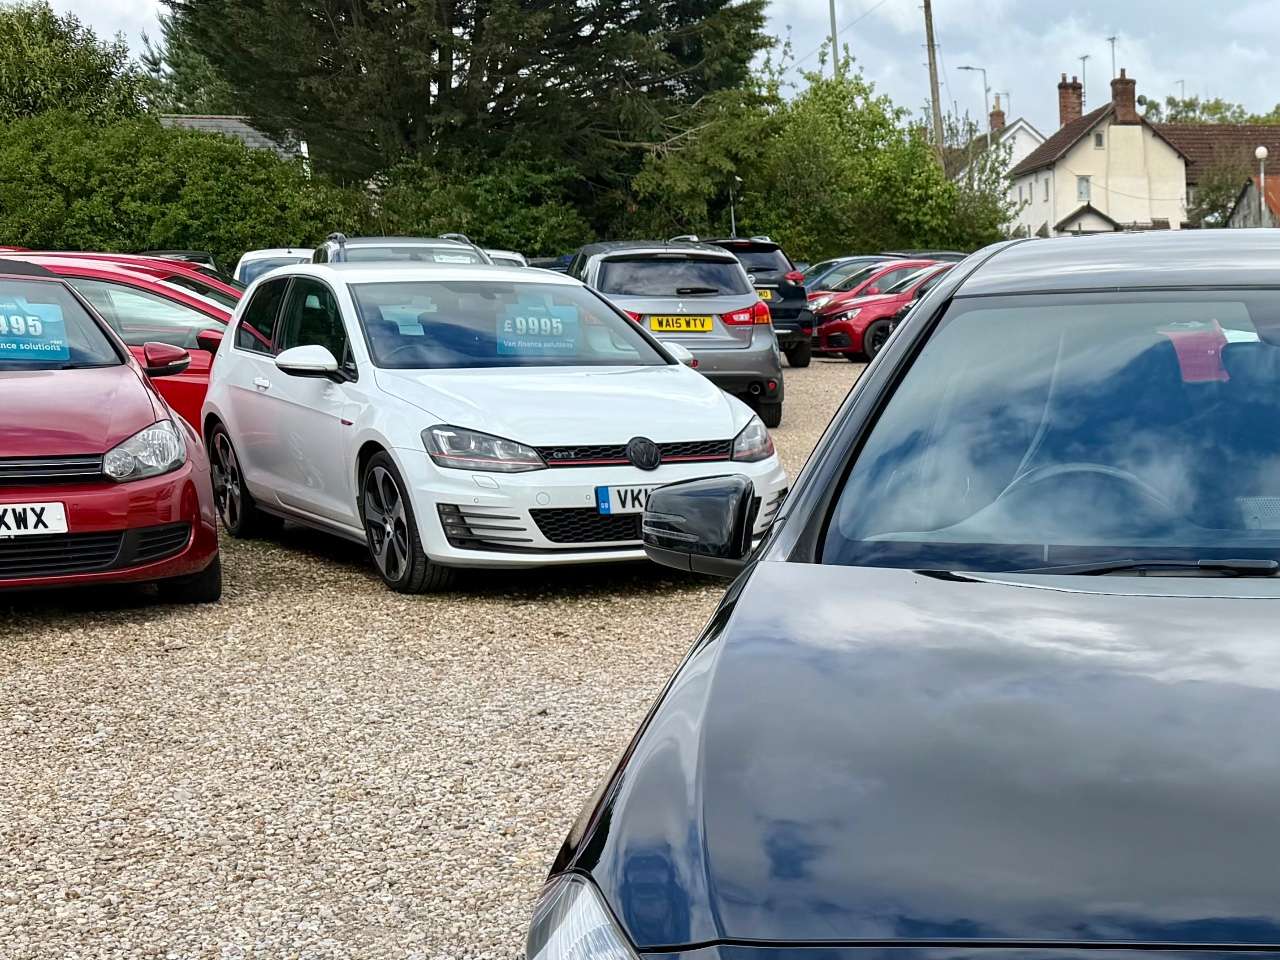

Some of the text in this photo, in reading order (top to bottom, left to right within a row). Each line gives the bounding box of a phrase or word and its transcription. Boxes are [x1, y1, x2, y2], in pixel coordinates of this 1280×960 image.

[657, 318, 706, 329] WA15 WTV
[20, 342, 61, 351] solutions
[553, 451, 576, 459] GTI
